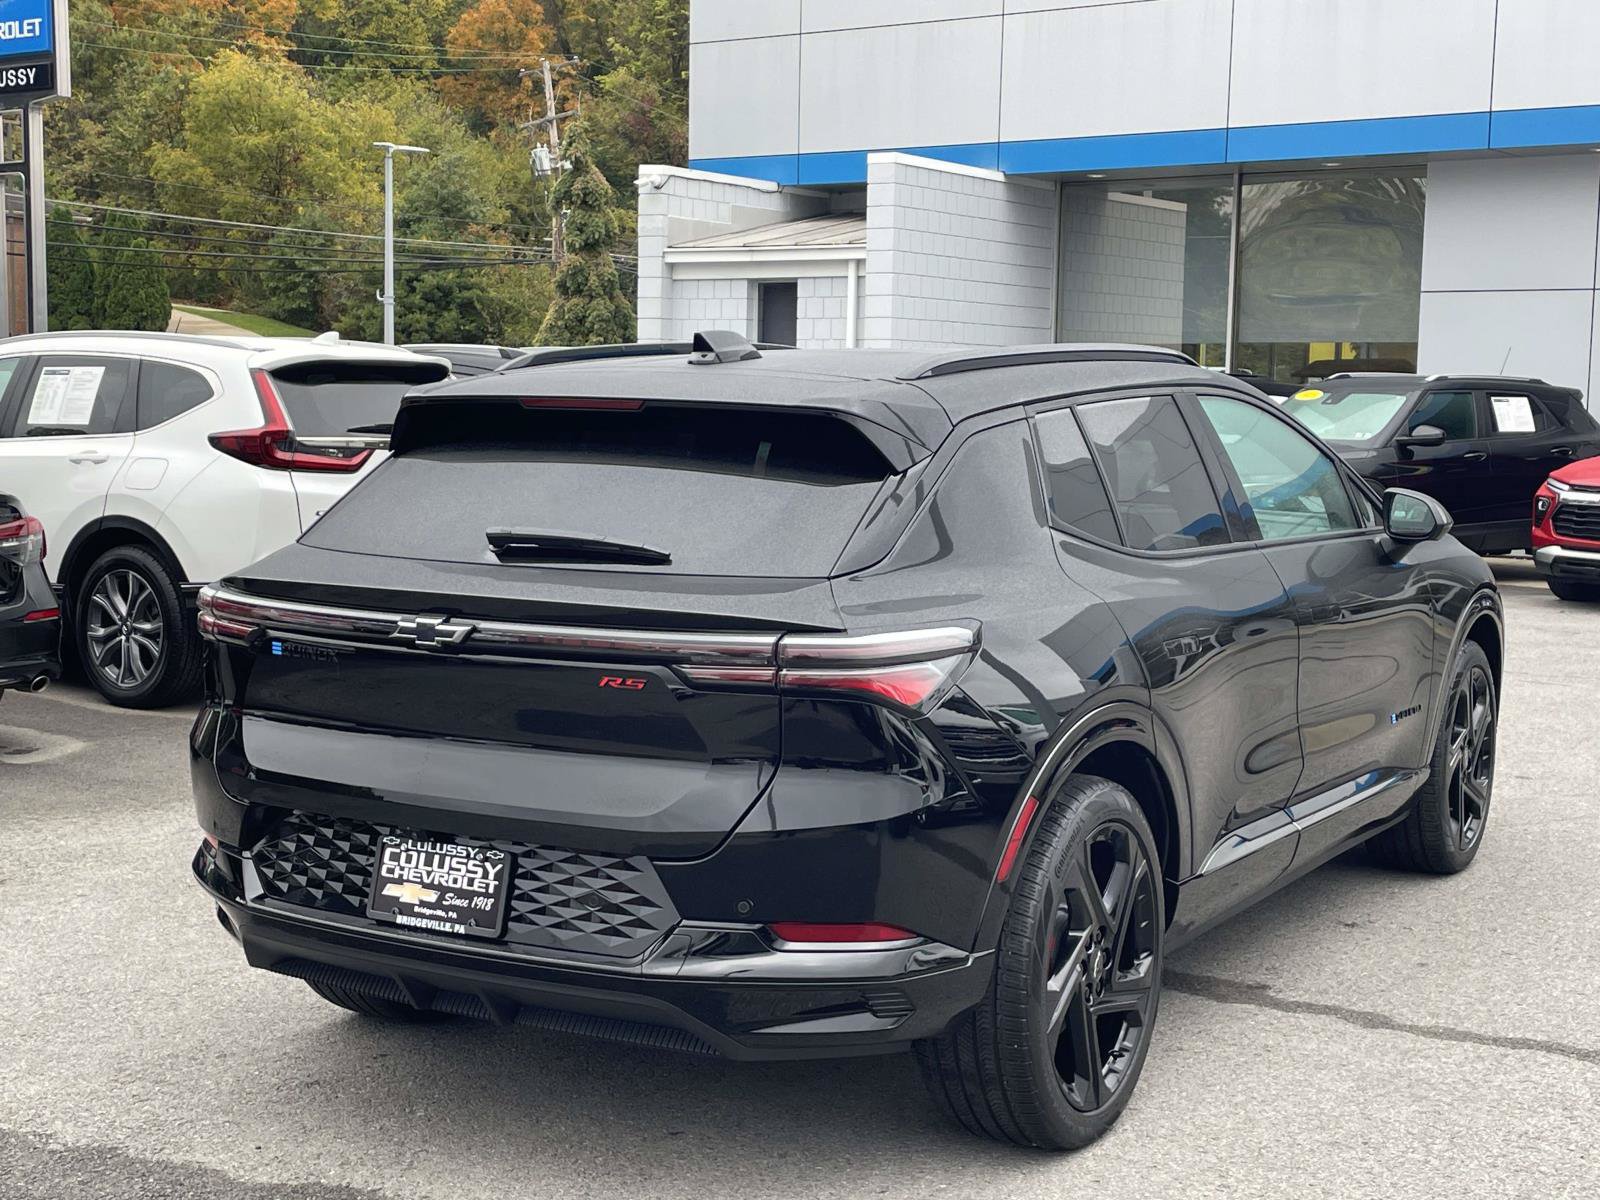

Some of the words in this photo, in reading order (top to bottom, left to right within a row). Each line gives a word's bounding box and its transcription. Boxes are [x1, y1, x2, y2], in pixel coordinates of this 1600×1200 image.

[0, 67, 36, 87] USSY
[598, 676, 647, 690] RS
[383, 847, 504, 881] COLUSSY
[381, 864, 499, 894] CHEVROLET
[442, 892, 469, 908] Since
[470, 896, 495, 911] 1918
[447, 911, 458, 919] PA
[453, 923, 466, 935] PA
